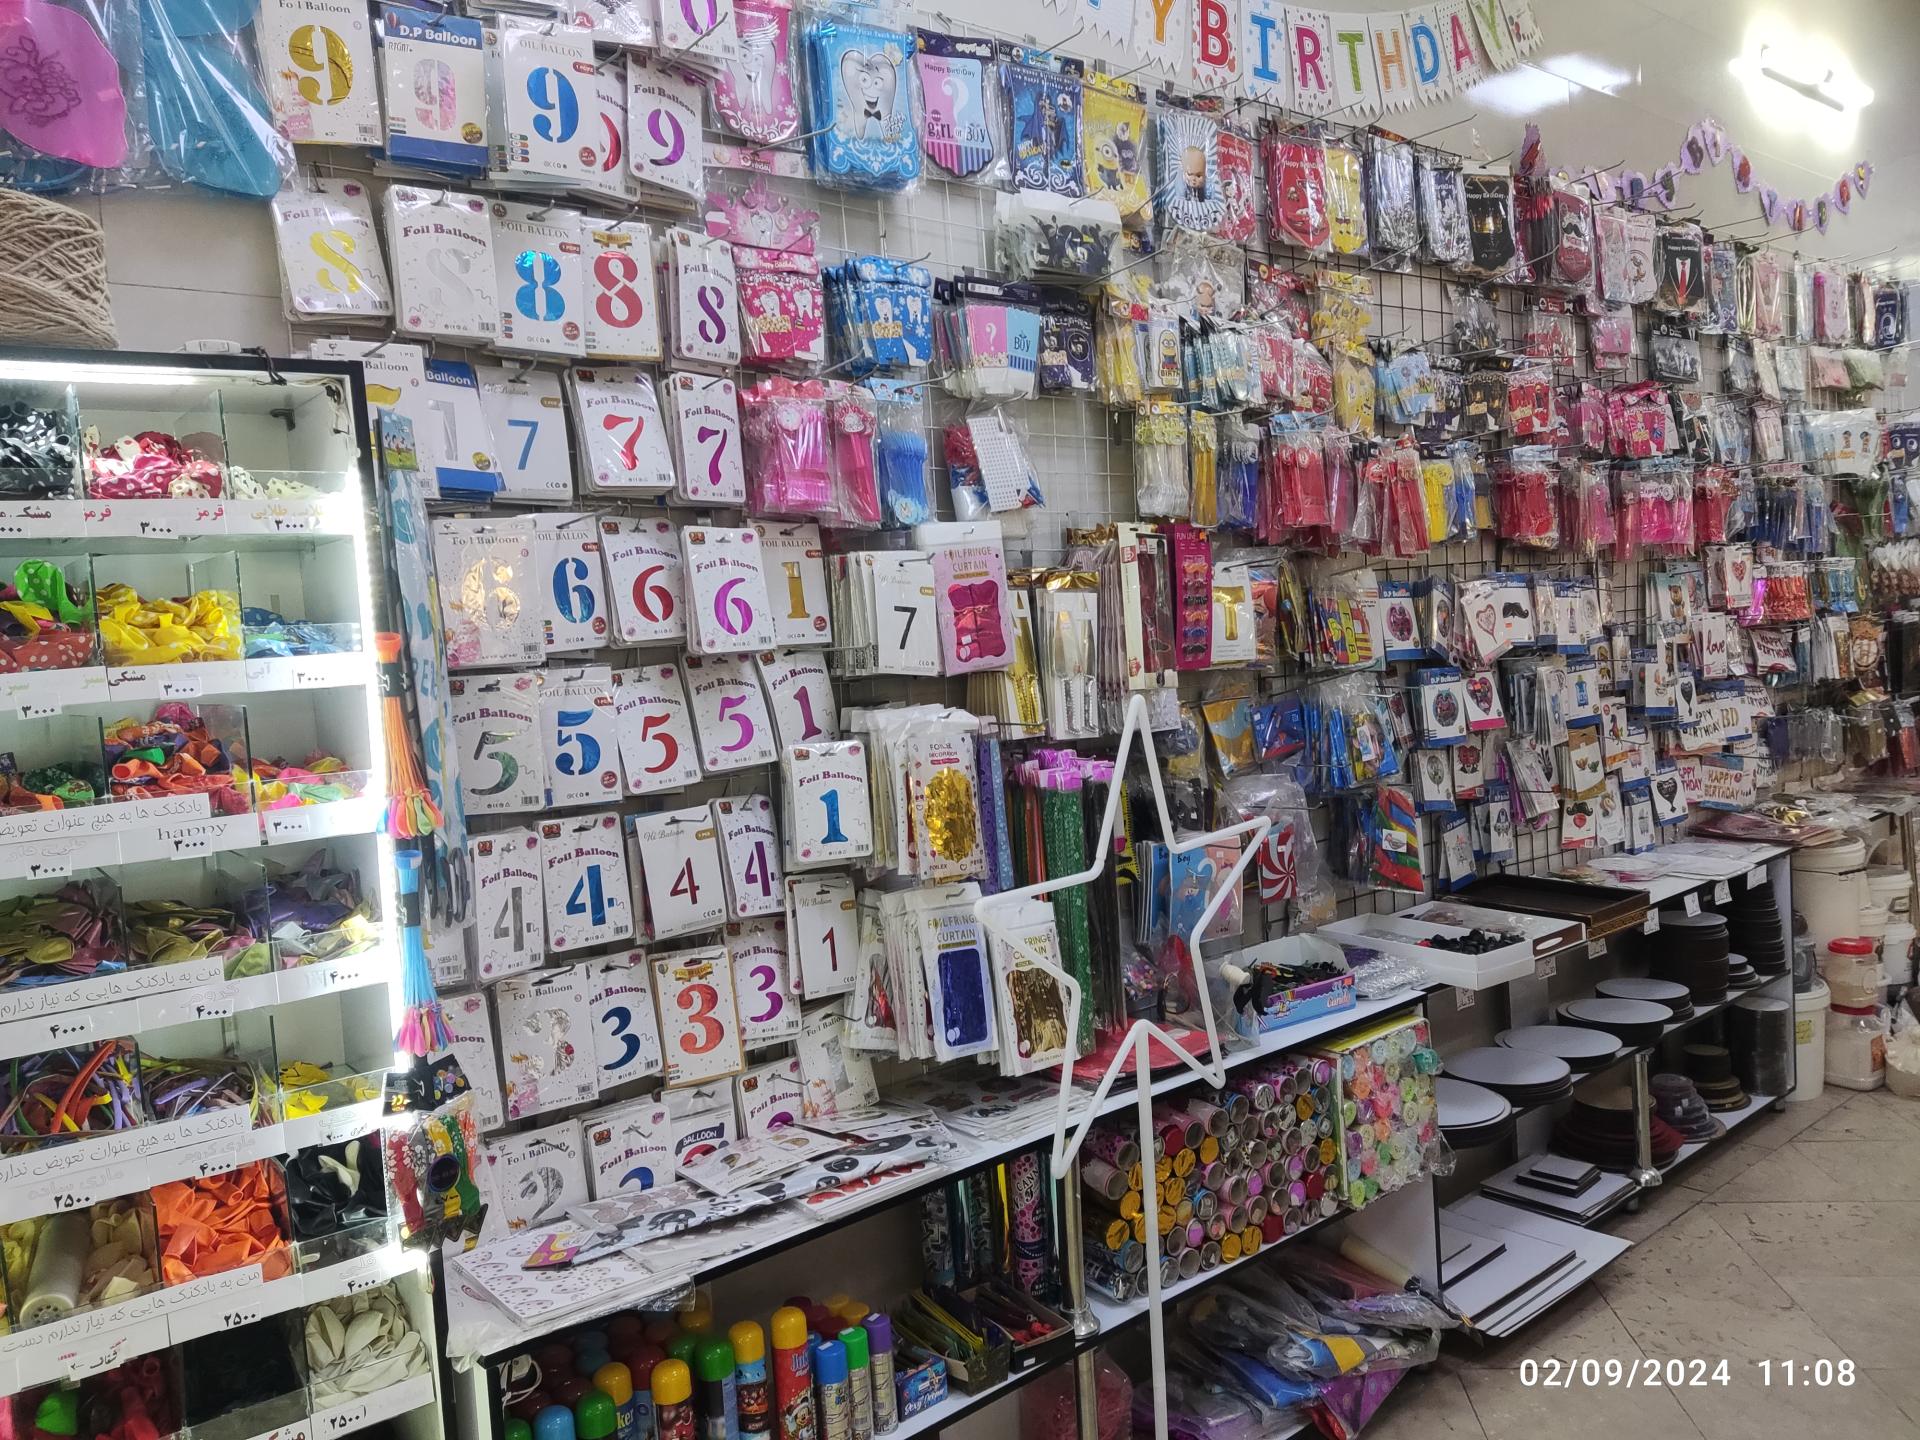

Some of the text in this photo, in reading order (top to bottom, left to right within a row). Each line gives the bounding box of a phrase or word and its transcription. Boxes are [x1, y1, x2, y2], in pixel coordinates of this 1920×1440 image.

[305, 1, 351, 14] Balloon
[400, 26, 477, 47] D.P Balloon
[541, 43, 583, 59] BALLON
[288, 25, 353, 106] 9
[924, 62, 945, 73] Happy
[413, 58, 457, 131] 9
[634, 84, 697, 118] Foil Balloon
[527, 66, 579, 144] 9
[648, 108, 685, 167] 9
[403, 224, 487, 248] Foil Balloon
[500, 221, 569, 239] FOIL BALLON
[684, 263, 700, 274] Foil
[514, 250, 566, 321] 8
[594, 251, 643, 328] 8
[365, 361, 408, 372] Balloon
[426, 371, 471, 385] Balloon
[586, 396, 655, 413] Foil Balloon
[685, 406, 736, 425] Foil Balloon
[508, 420, 539, 471] 7
[603, 414, 644, 471] 7
[697, 426, 728, 486] 7
[140, 521, 172, 534] ۳۰۰۰
[275, 519, 304, 531] ۳۰۰۰
[555, 532, 589, 541] BALLON
[762, 539, 813, 548] FOIL BALLON
[612, 546, 677, 562] Foil Balloon
[696, 557, 758, 573] Foil Balloon
[953, 560, 987, 573] CURTAIN
[462, 557, 521, 632] 6
[553, 557, 595, 623] 6
[632, 565, 674, 623] 6
[781, 561, 810, 619] 1
[714, 577, 753, 635] 6
[894, 605, 917, 650] 7
[1706, 629, 1725, 655] love
[108, 670, 146, 686] مشکی
[695, 678, 756, 696] Foil Balloon
[772, 667, 824, 691] Foil Balloon
[164, 683, 194, 696] ۳۰۰۰
[564, 686, 603, 696] BALLON
[22, 705, 55, 718] ۳۰۰۰
[616, 700, 637, 715] Foil
[639, 696, 682, 707] Balloon
[793, 685, 822, 741] 1
[479, 708, 533, 723] Balloon
[719, 695, 754, 752] 5
[555, 708, 601, 776] 5
[641, 713, 678, 773] 5
[470, 731, 519, 796] 5
[799, 771, 863, 787] Foil Balloon
[1708, 770, 1733, 784] HAPPY
[1704, 785, 1740, 800] BIRTHDAY
[44, 799, 202, 833] بادکنک ها به هیچ عنوان
[820, 789, 849, 844] 1
[273, 821, 302, 833] ۳۰۰۰
[728, 825, 775, 840] Foil Balloon
[173, 840, 205, 853] ۳۰۰۰
[548, 848, 619, 869] Foil Balloon
[30, 864, 64, 878] ۳۰۰۰
[481, 868, 538, 889] Foil Balloon
[745, 841, 775, 897] 4
[670, 857, 700, 905] 4
[565, 864, 614, 927] 4
[494, 886, 532, 952] 4
[937, 930, 976, 943] CURTAIN
[1024, 934, 1052, 945] FRINGE
[733, 950, 750, 961] Foil
[822, 926, 837, 972] 1
[0, 967, 221, 1018] من به بادکنک هایی که نیاز ندارم
[535, 984, 573, 997] Balloon
[605, 986, 647, 997] Balloon
[750, 965, 783, 1023] 3
[196, 1005, 228, 1019] ۴۰۰۰
[677, 984, 725, 1054] 3
[50, 1024, 85, 1039] ۴۰۰۰
[601, 1006, 640, 1071] 3
[524, 1008, 574, 1079] 3
[750, 1104, 768, 1119] Foil
[32, 1113, 244, 1177] بادکنک ها به هیچ عنوان تعویض
[683, 1130, 717, 1145] BALLOON
[200, 1162, 231, 1176] ۴۰۰۰
[600, 1145, 667, 1175] Foil Balloon
[54, 1194, 91, 1209] ۲۵۰۰
[519, 1166, 564, 1220] 2
[348, 1278, 376, 1293] ۴۰۰۰
[1, 1271, 260, 1350] من به بادکنک هایی که نیاز ندارم دست
[224, 1312, 257, 1328] ۲۵۰۰
[330, 1413, 360, 1429] ۲۵۰۰
